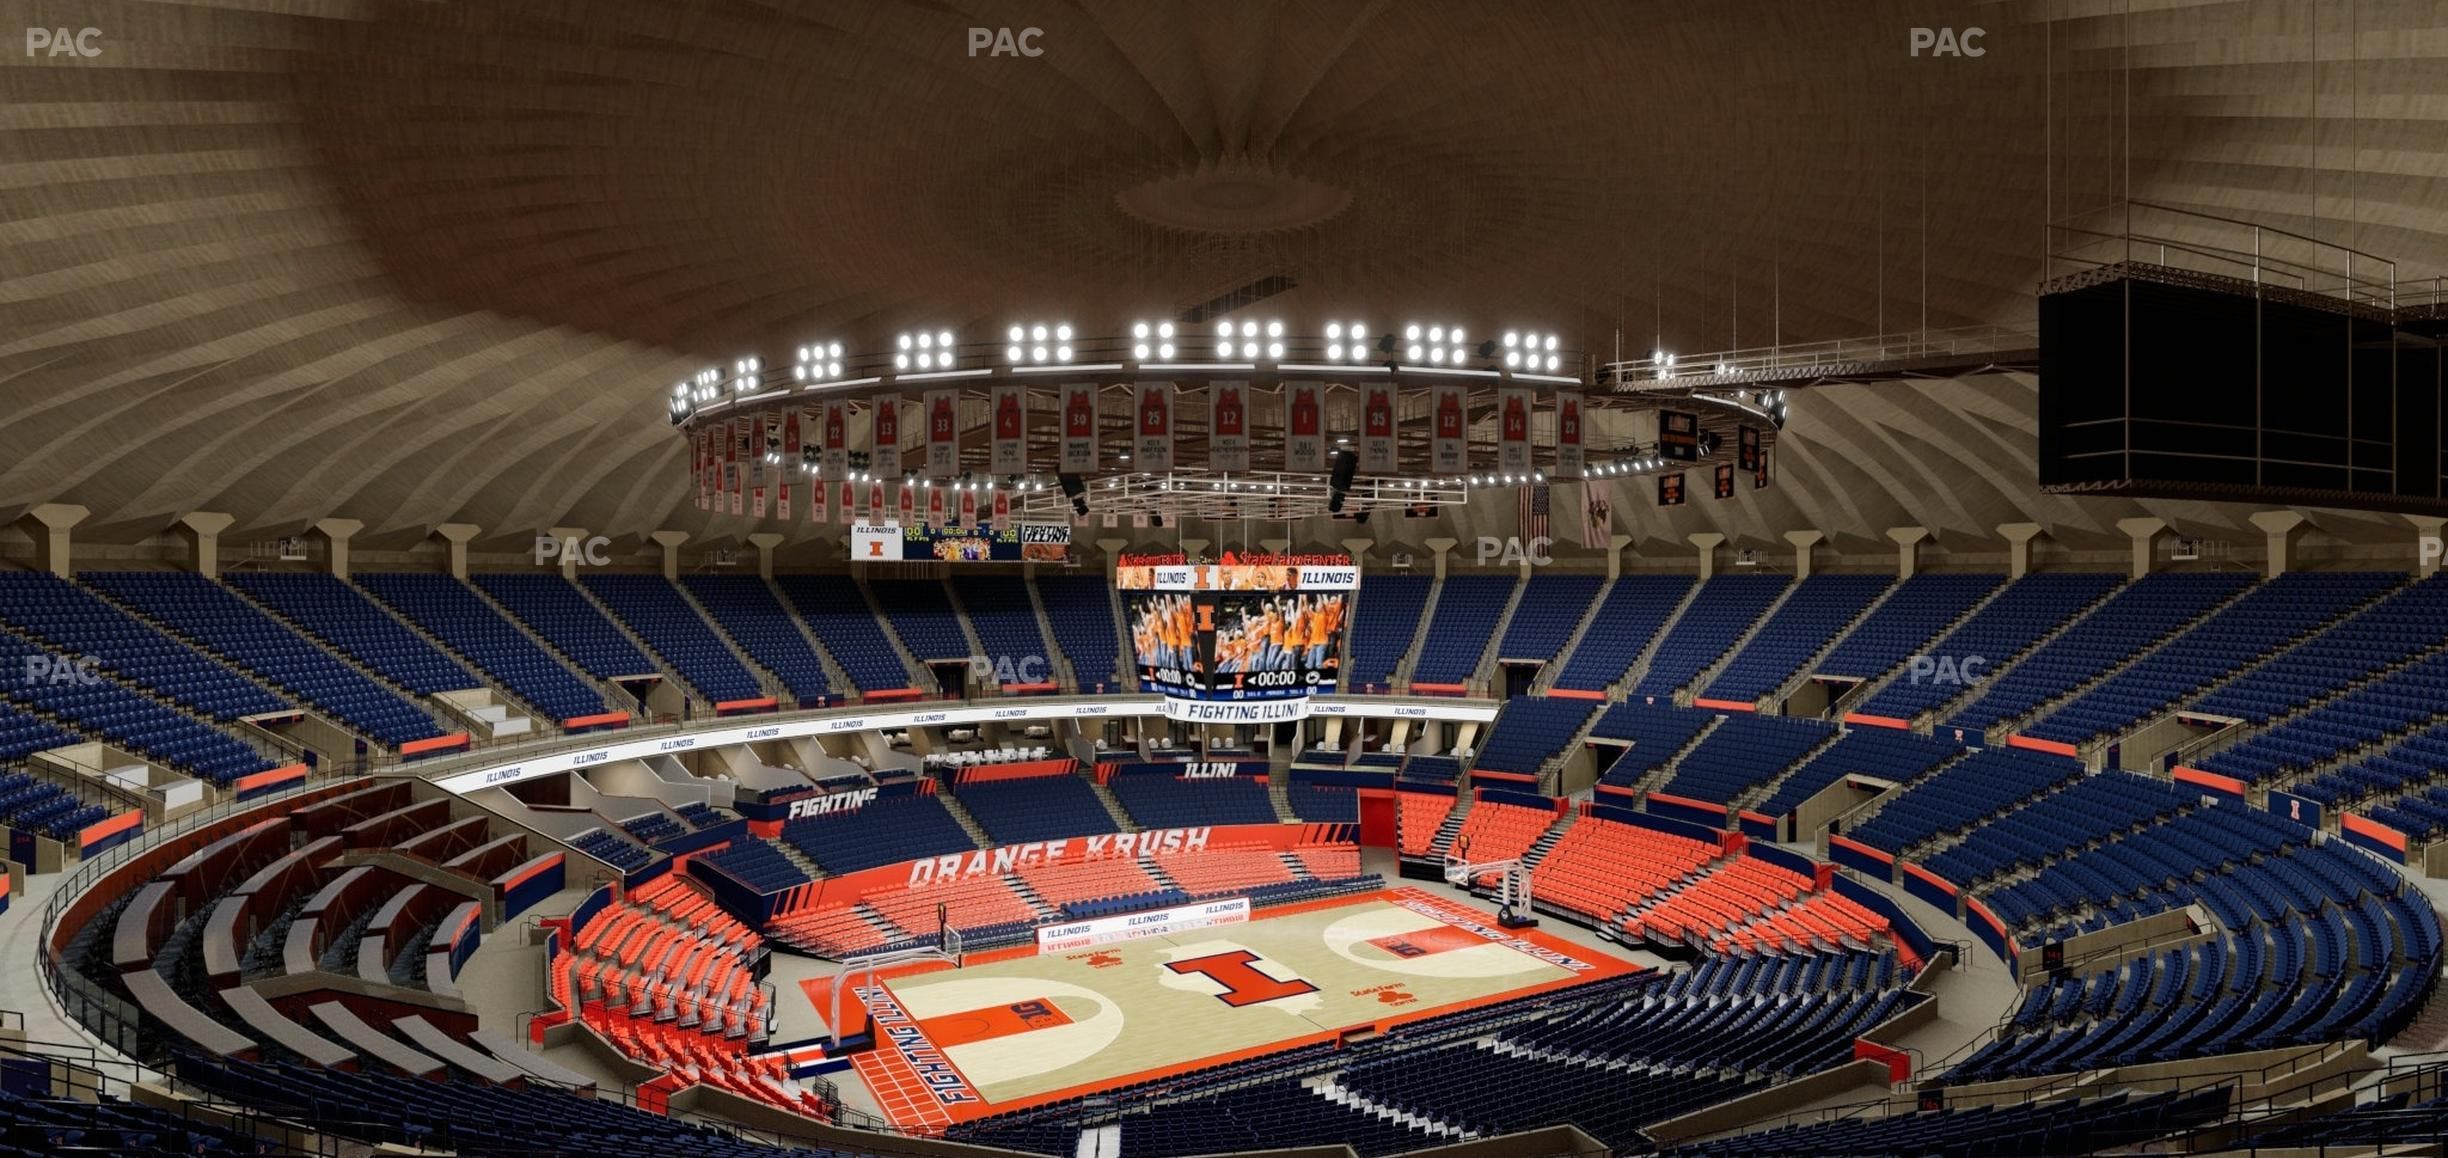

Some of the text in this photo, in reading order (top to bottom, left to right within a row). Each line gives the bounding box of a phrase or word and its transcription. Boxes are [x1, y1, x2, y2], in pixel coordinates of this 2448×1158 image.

[1223, 411, 1237, 425] 12
[1443, 416, 1456, 428] 12
[856, 526, 897, 535] ILLINOIS
[1156, 572, 1187, 584] ILLINOIS
[1302, 572, 1355, 584] ILLINOIS
[1258, 671, 1296, 686] 00:00
[1233, 690, 1244, 699] 00
[1305, 686, 1317, 695] 00
[995, 709, 1027, 718] ILLINOIS
[1076, 706, 1107, 715] ILLINOIS
[1188, 703, 1299, 720] FIGHTING ILLINI
[1314, 705, 1346, 713] ILLINOIS
[1394, 707, 1426, 716] ILLINOIS
[831, 719, 864, 729] ILLINOIS
[914, 713, 946, 722] ILLINOIS
[747, 727, 779, 739] ILLINOIS
[660, 738, 695, 751] ILLINOIS
[573, 751, 608, 765] ILLINOIS
[485, 767, 521, 783] ILLINOIS
[1184, 762, 1237, 779] ILLINI
[788, 787, 878, 820] FIGHTING
[908, 827, 1211, 888] ORANGE KRUSH
[1205, 901, 1244, 914] ILLINOIS
[1128, 912, 1170, 926] ILLINOIS
[1047, 924, 1091, 939] ILLINOIS
[883, 1026, 980, 1106] FIGHTING
